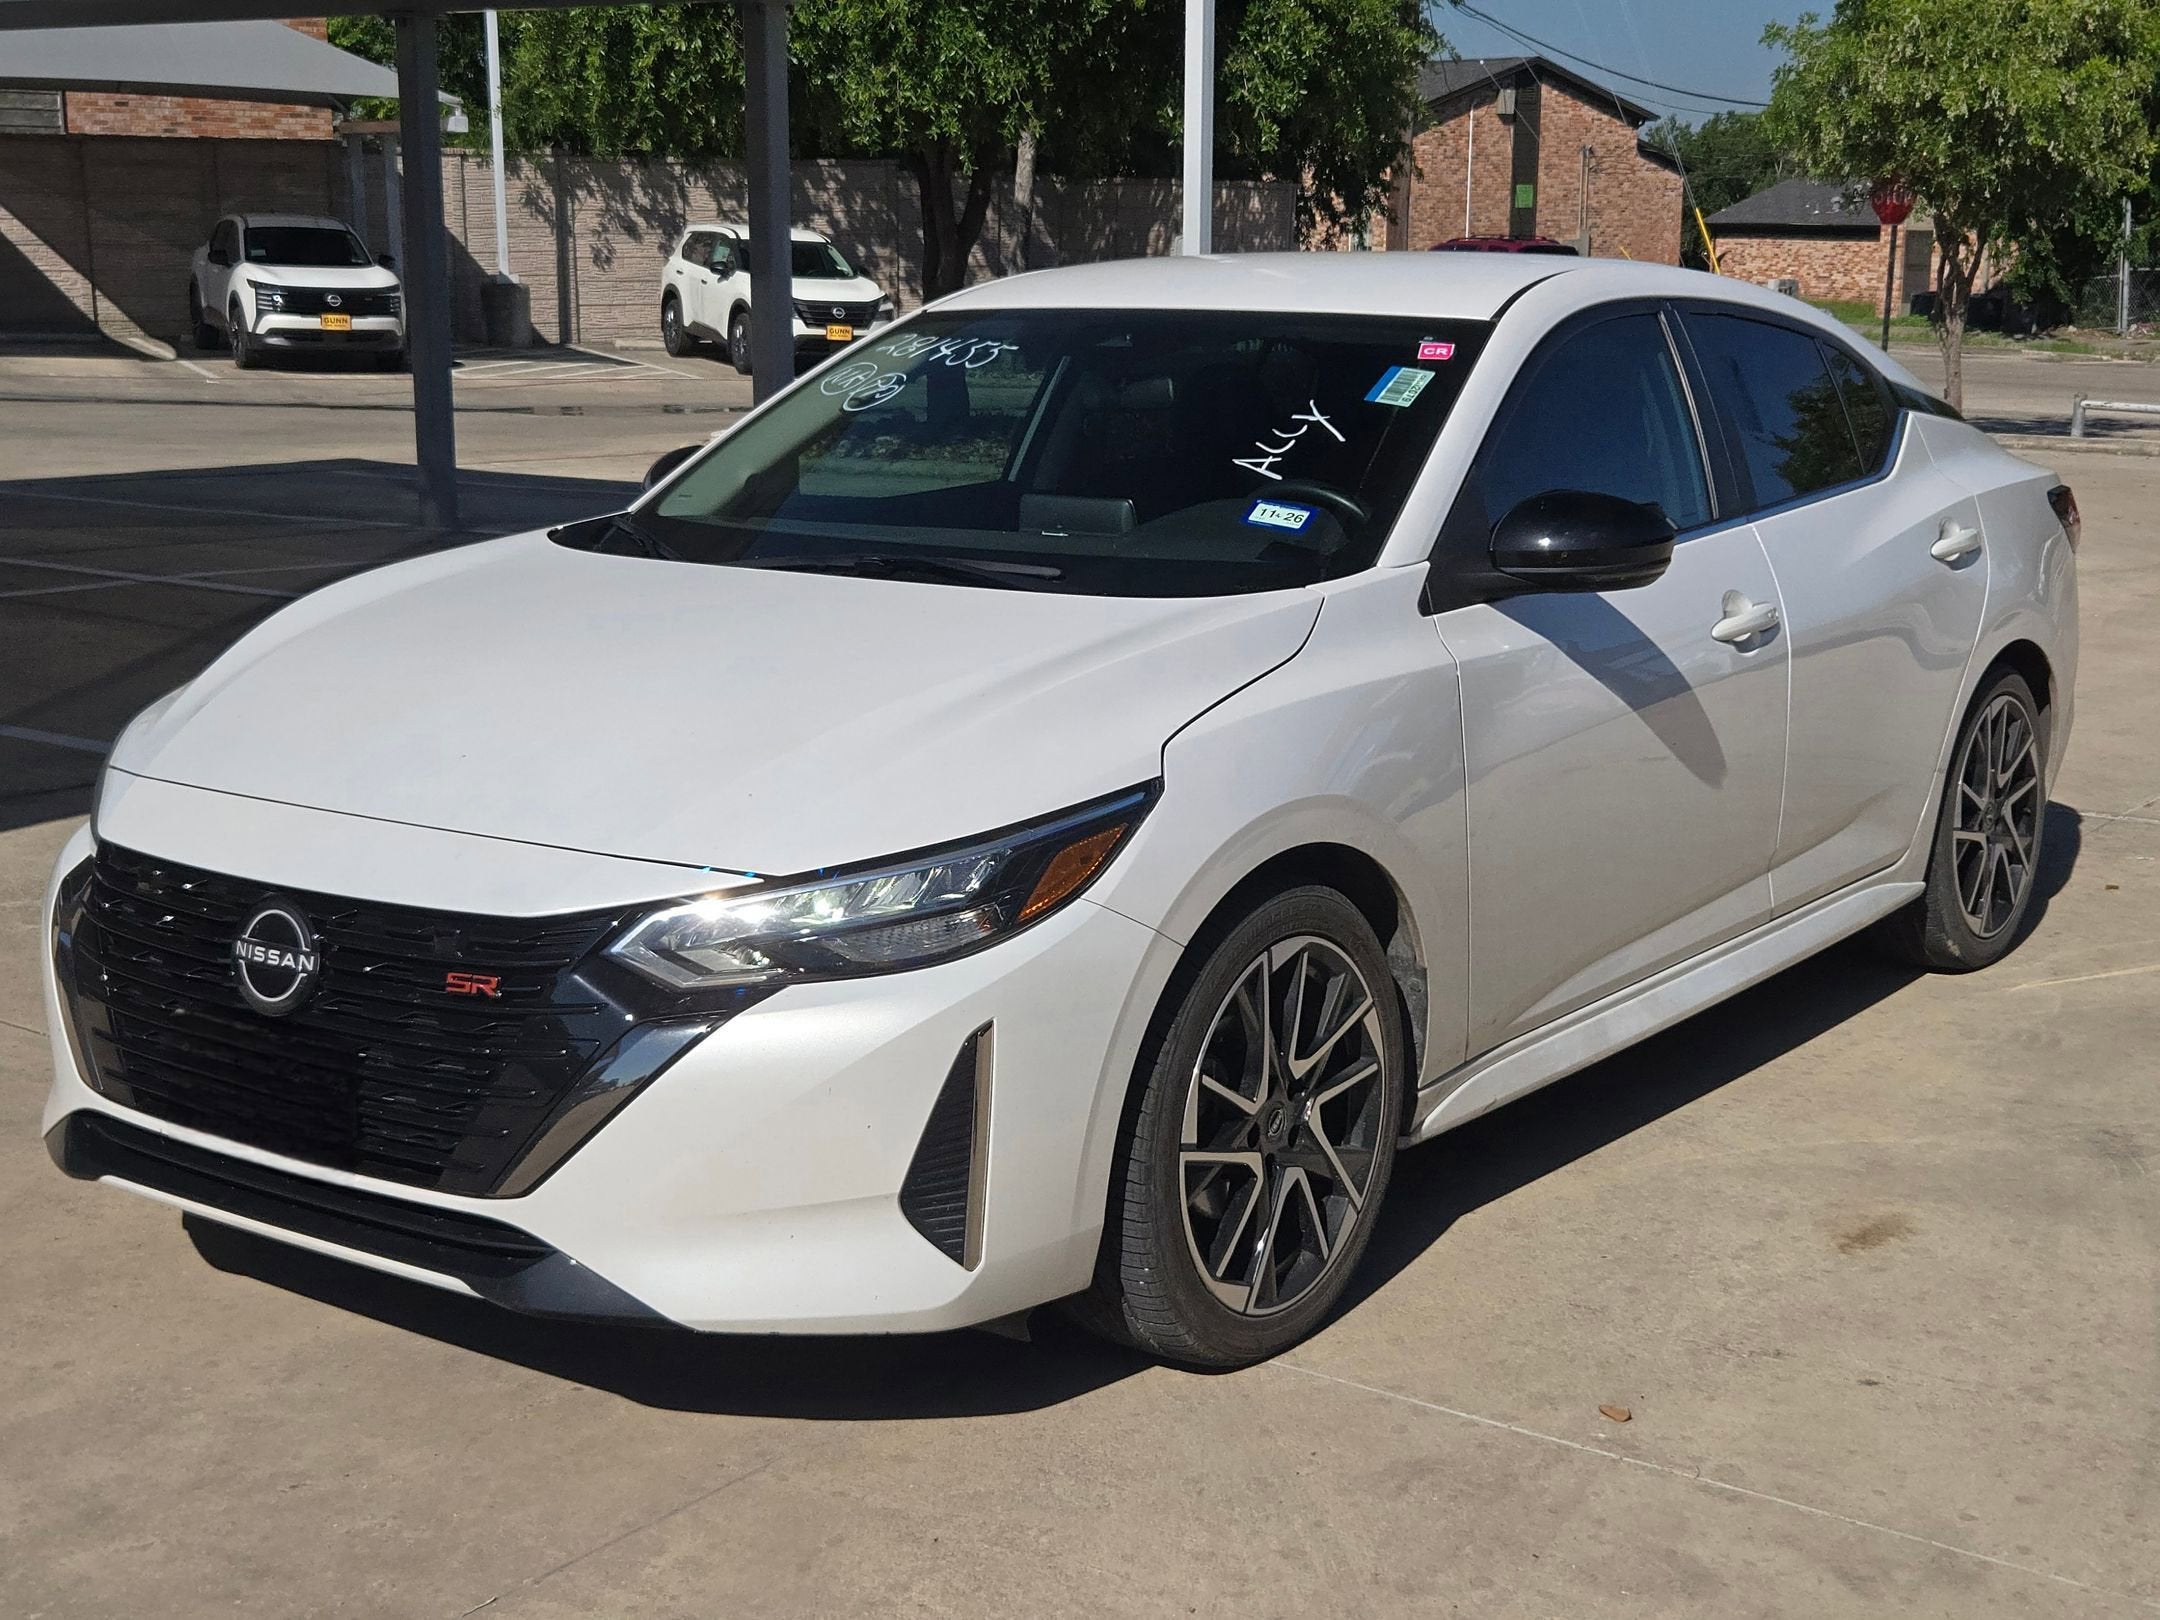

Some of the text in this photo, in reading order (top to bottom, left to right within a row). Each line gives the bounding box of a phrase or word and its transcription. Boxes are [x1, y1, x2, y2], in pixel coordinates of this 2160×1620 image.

[1423, 347, 1449, 355] CR
[235, 939, 315, 972] NISSAN
[445, 971, 502, 997] SR
